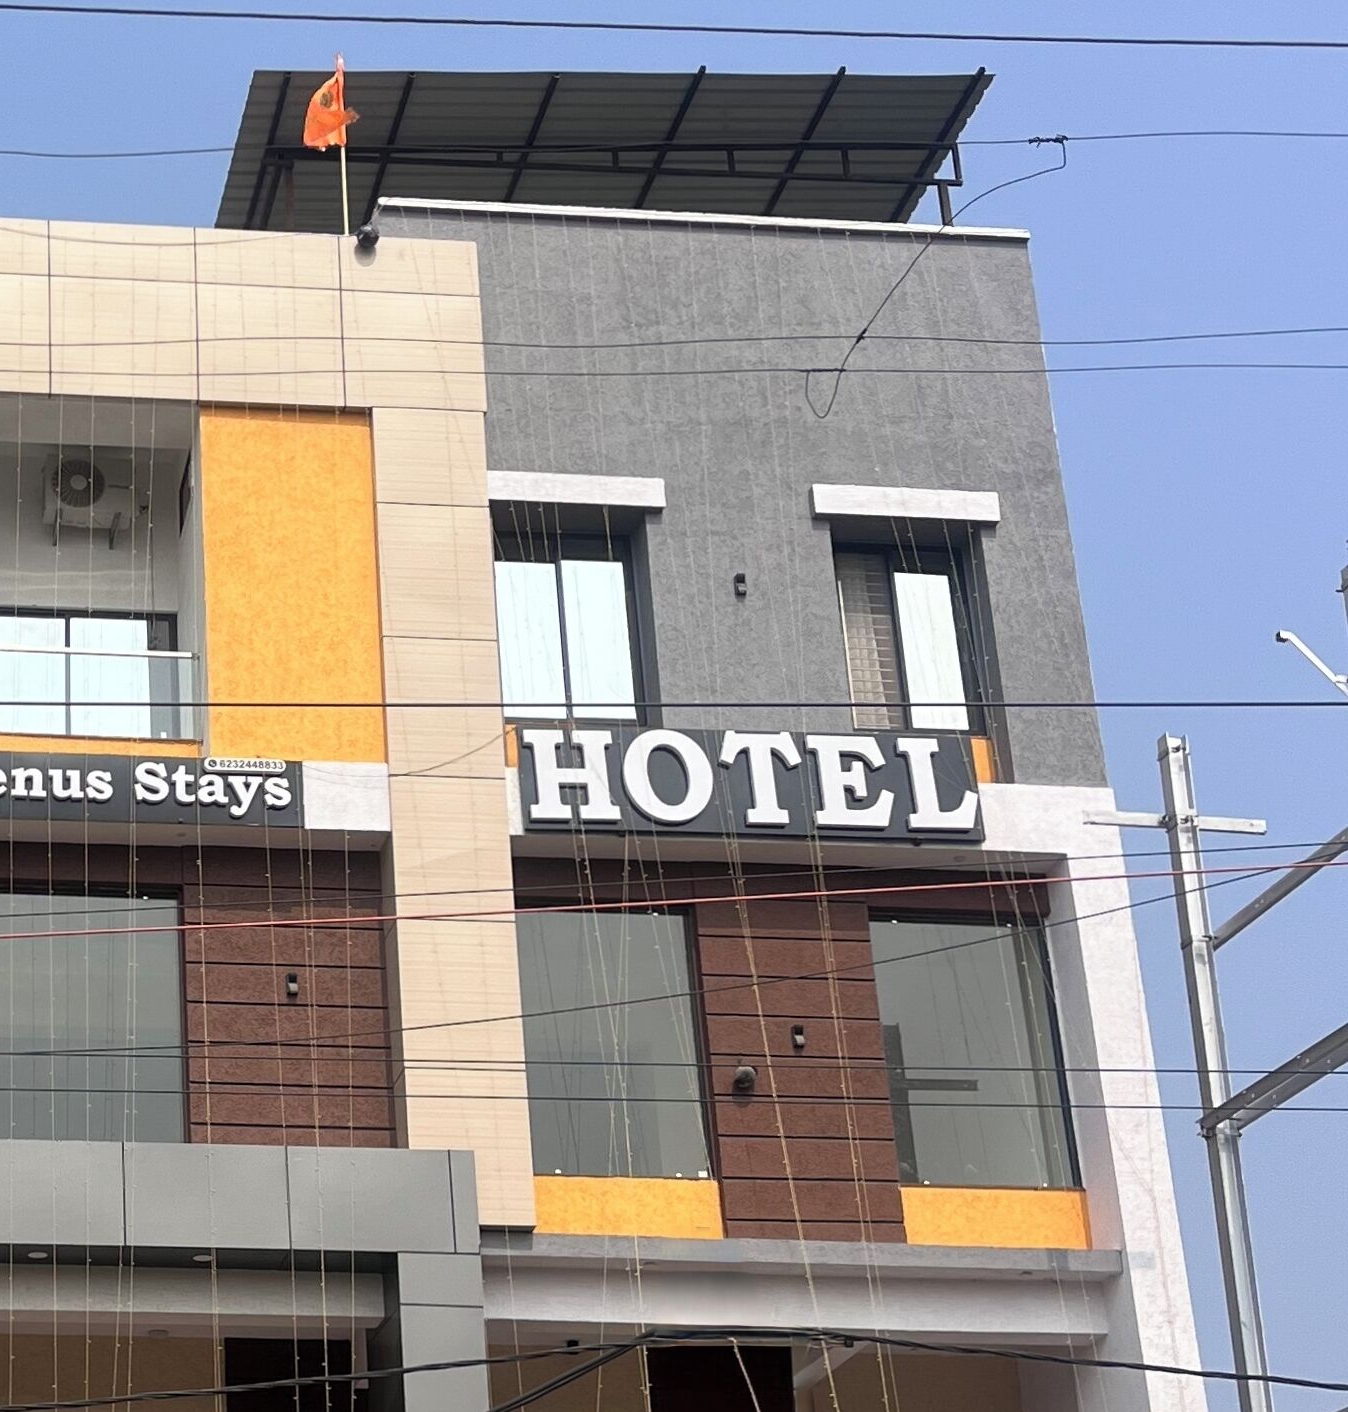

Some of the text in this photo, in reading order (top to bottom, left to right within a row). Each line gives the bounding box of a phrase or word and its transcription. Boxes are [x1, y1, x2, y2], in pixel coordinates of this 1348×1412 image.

[134, 760, 293, 817] Stays
[219, 759, 284, 769] 6232448833
[522, 728, 979, 830] HOTEL
